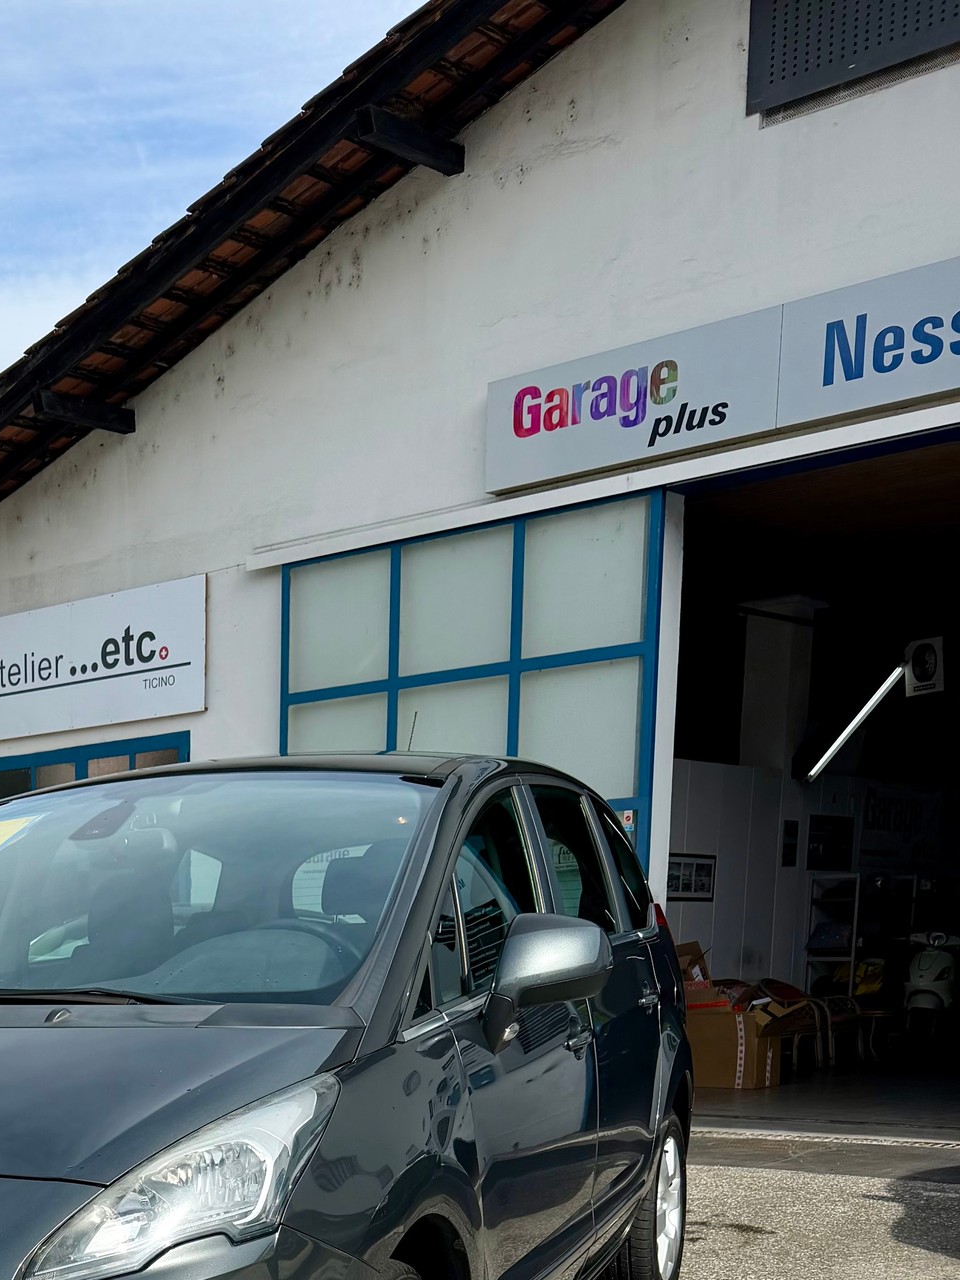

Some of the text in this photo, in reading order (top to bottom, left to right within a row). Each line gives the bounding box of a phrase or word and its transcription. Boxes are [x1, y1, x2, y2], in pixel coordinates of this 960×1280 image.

[513, 359, 679, 439] Garage
[647, 401, 729, 447] plus
[142, 674, 176, 690] TICINO
